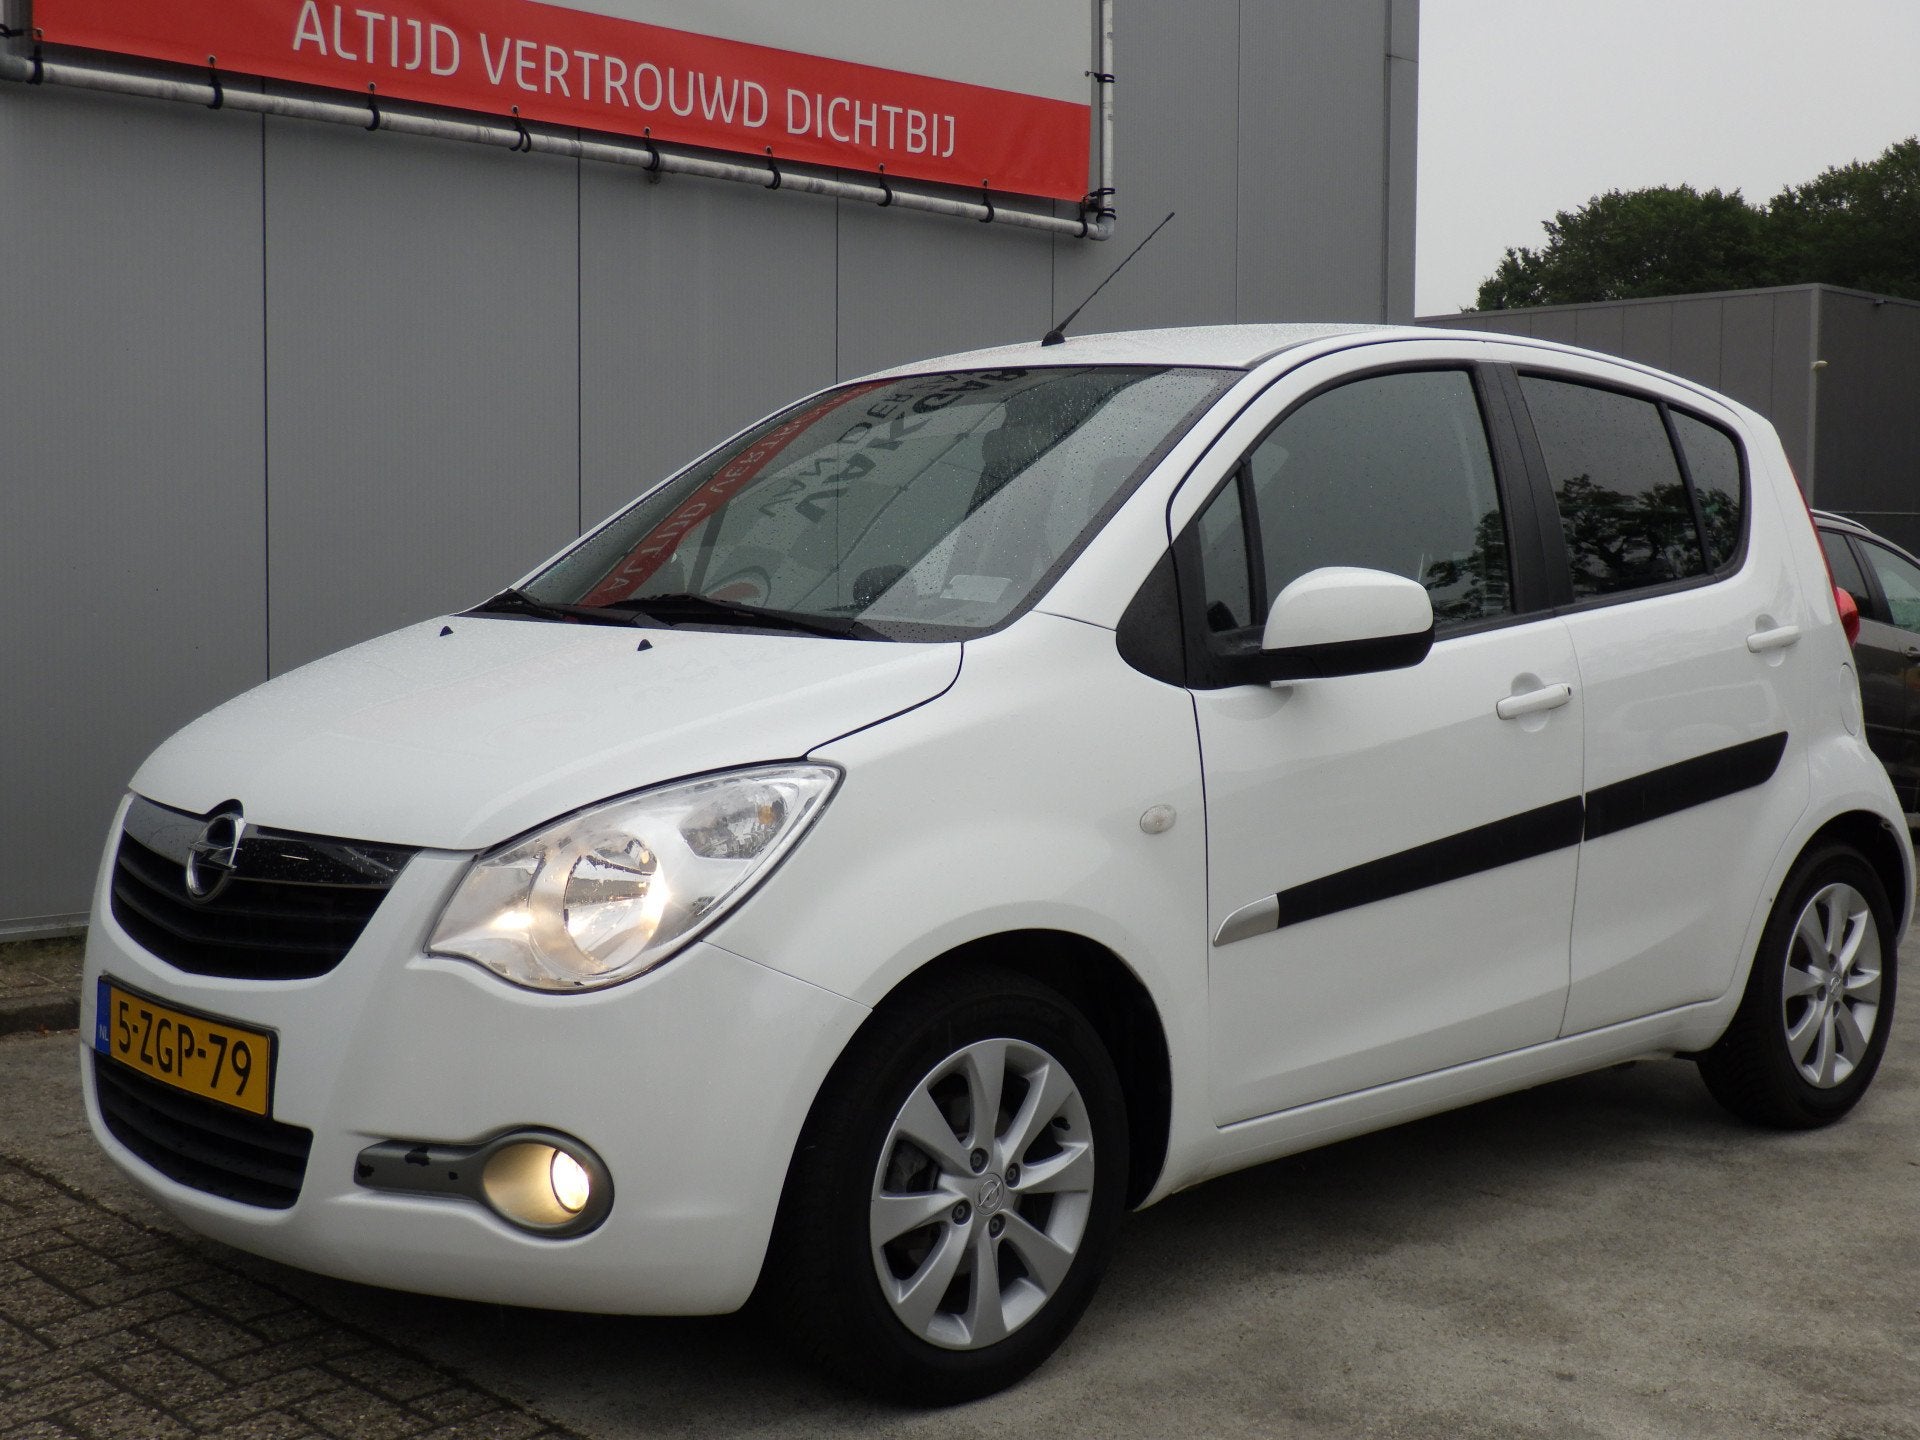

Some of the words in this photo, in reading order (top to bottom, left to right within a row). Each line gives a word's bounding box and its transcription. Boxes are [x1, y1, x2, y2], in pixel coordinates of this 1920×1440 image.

[292, 0, 460, 77] ALTIJD
[479, 32, 769, 128] VERTROUWD
[786, 88, 956, 158] DICHTBIJ
[99, 1023, 109, 1042] NL
[118, 1000, 252, 1096] 5-ZGP-79
